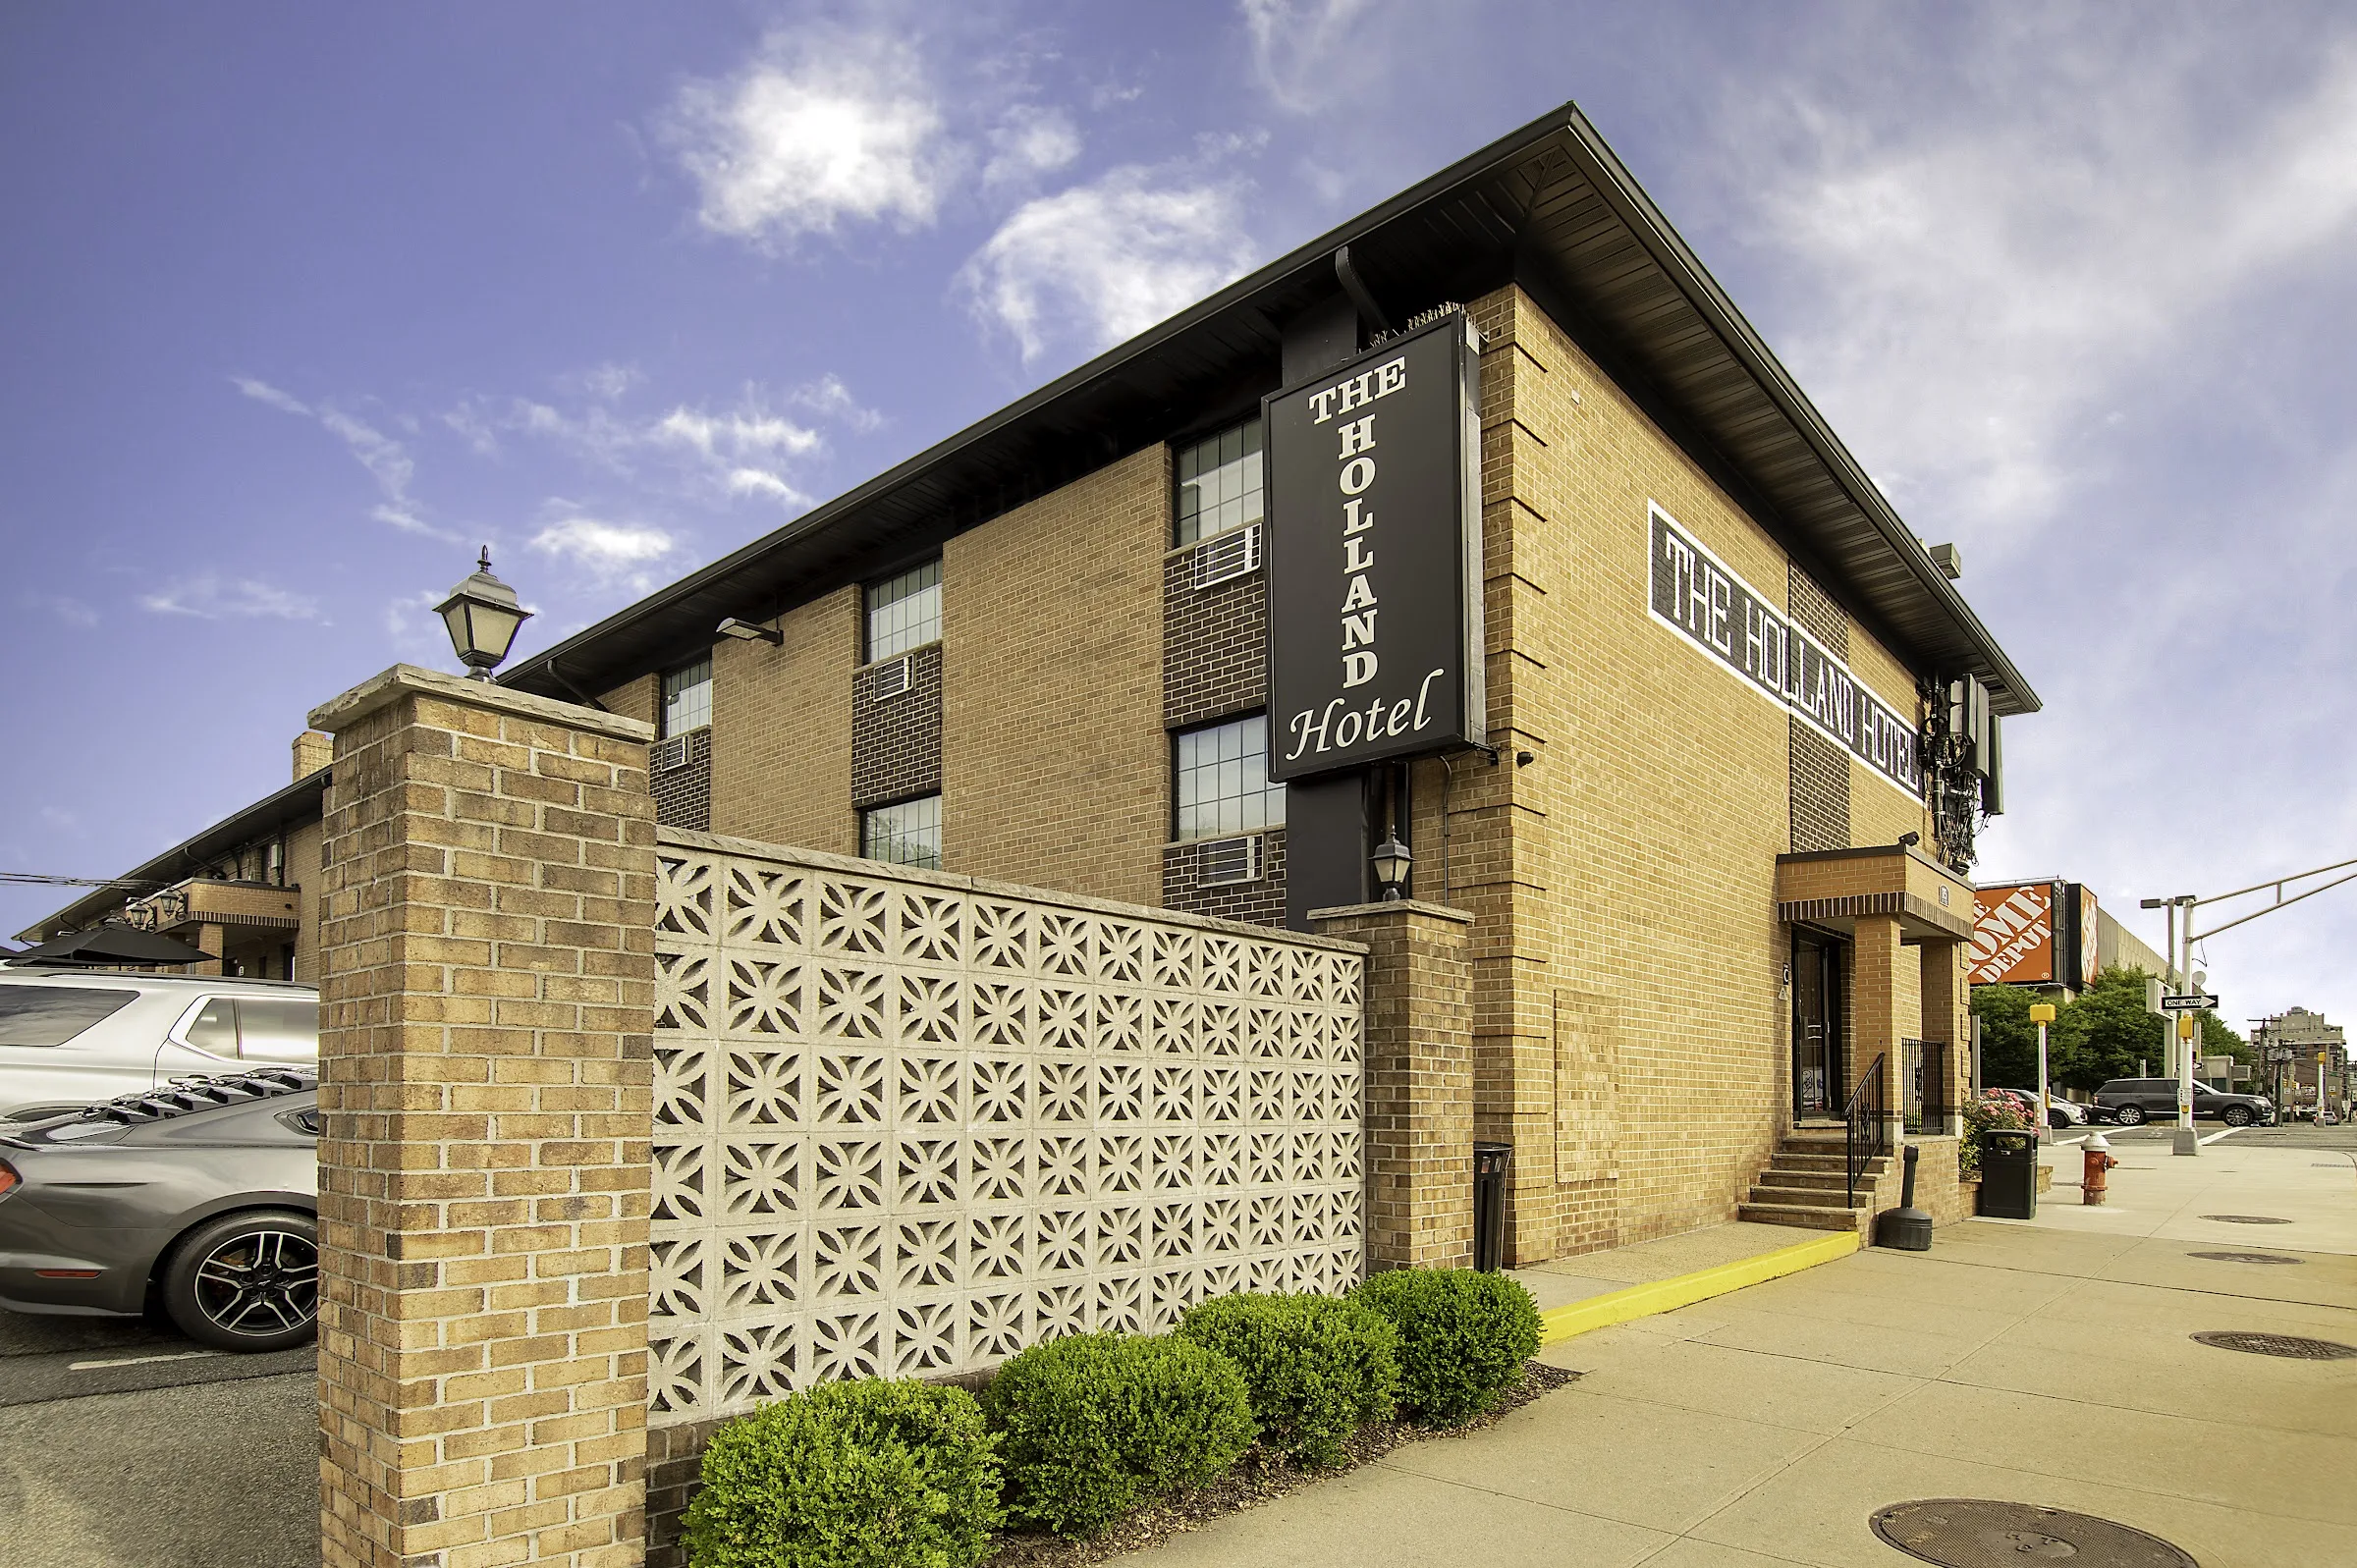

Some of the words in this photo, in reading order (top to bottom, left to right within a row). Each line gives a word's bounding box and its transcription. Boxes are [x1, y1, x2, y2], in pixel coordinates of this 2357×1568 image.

[1309, 356, 1407, 425] THE
[1338, 414, 1378, 689] HOLLAND
[1666, 531, 1731, 658] THE
[1745, 597, 1855, 744] HOLLAND
[1862, 694, 1919, 792] HOTEL
[1285, 669, 1445, 761] Hotel
[1967, 886, 2052, 976] OME
[1976, 919, 2052, 983] DEPOT
